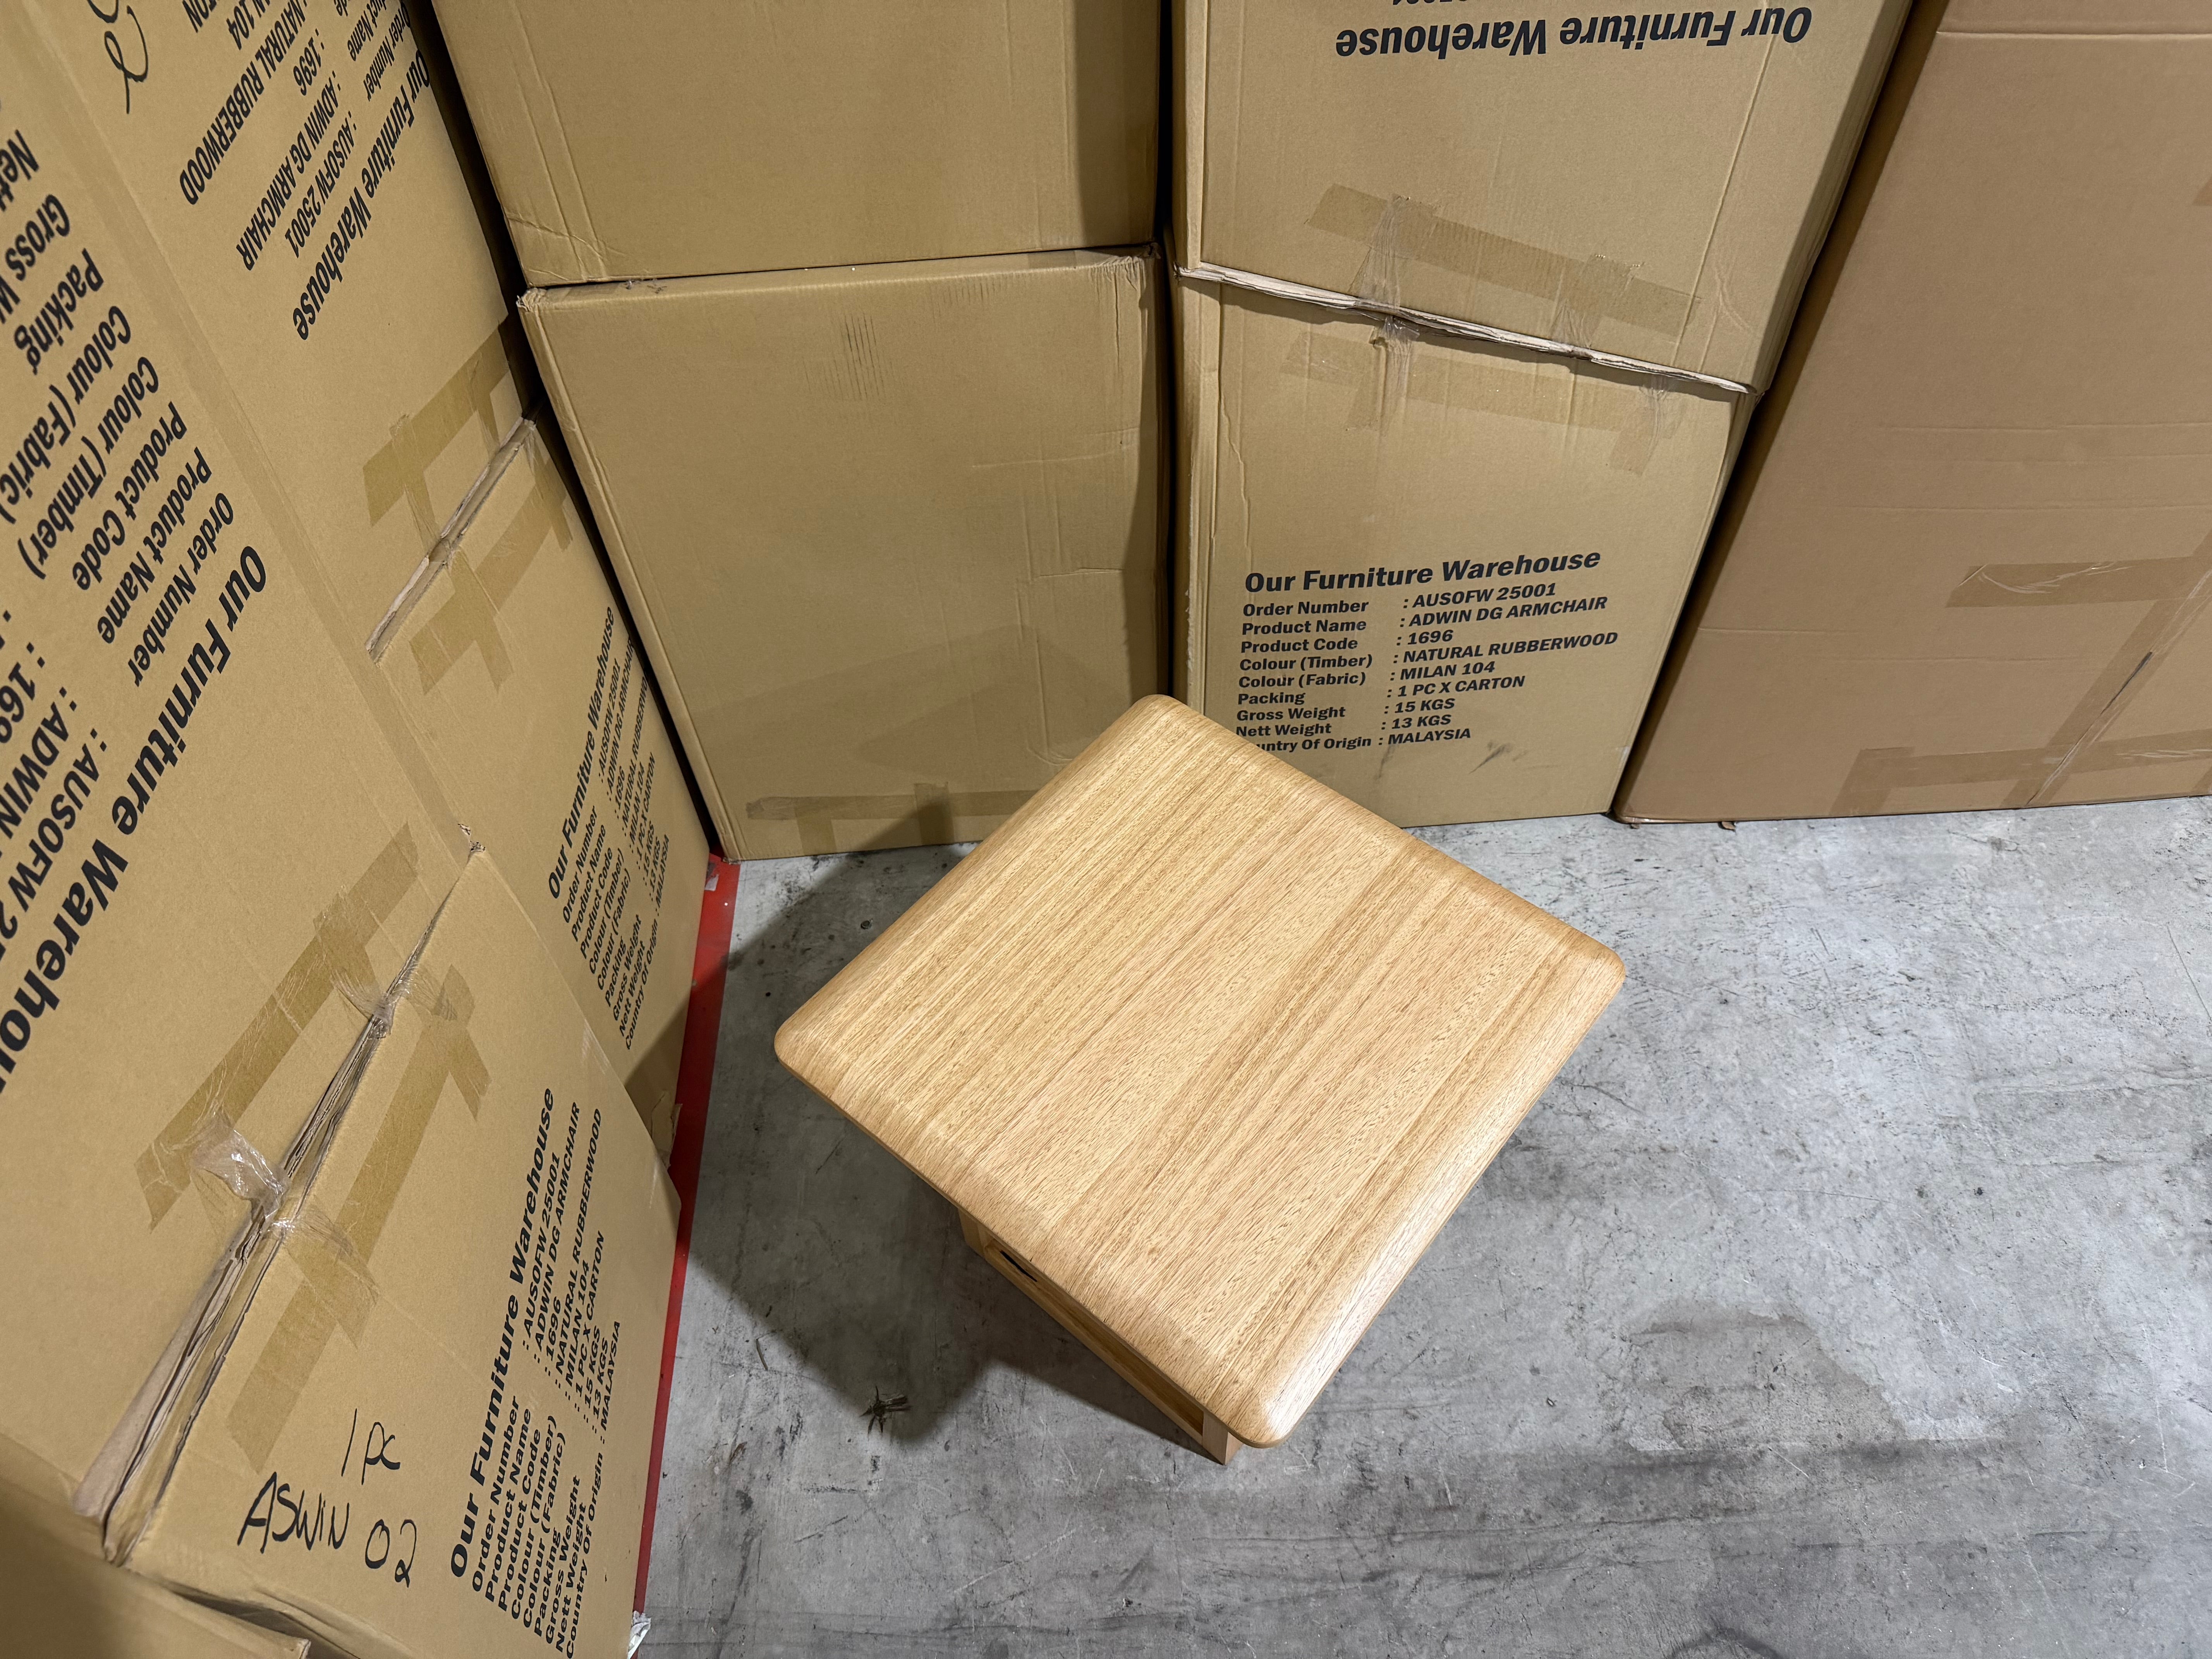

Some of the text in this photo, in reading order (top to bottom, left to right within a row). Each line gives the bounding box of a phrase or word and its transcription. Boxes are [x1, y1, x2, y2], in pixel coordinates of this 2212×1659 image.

[226, 0, 254, 51] 104
[255, 0, 306, 79] NATURAL
[293, 37, 321, 96] 1696
[363, 36, 395, 102] Number
[1336, 7, 1812, 60] Our Furniture Warehouse
[180, 61, 264, 205] RUBBERWOOD
[236, 10, 374, 271] Name ADWIN DG ARMCHAIR
[293, 42, 430, 340] Our Furniture Warehouse
[315, 117, 354, 205] AUSOFW
[5, 194, 70, 281] Gross
[285, 184, 321, 258] 25001
[14, 248, 104, 375] Packing
[67, 306, 131, 405] Colour
[17, 357, 159, 580] Colour (Timber)
[114, 401, 187, 521] Product
[143, 447, 212, 565] Product
[72, 510, 125, 590] Code
[97, 551, 155, 644] Name
[218, 546, 266, 632] Our
[1242, 596, 1607, 635] Product Name ADWIN DG ARMCHAIR
[1243, 582, 1556, 617] Order Number AUSOFW 25001
[1245, 552, 1601, 592] Our Furniture Warehouse
[8, 493, 234, 912] Order Number AUSOFW
[1237, 698, 1455, 721] Gross Weight 15 KGS
[1238, 675, 1525, 705] Packing 1 PC X CARTON
[1239, 661, 1495, 688] Colour (Fabric) MILAN 104
[1240, 632, 1618, 671] Colour (Timber) NATURAL RUBBERWOOD
[1241, 629, 1454, 653] Product Code 1696
[112, 618, 231, 835] Furniture
[548, 606, 614, 899] Our Furniture Warehouse
[563, 658, 620, 923] Order Number AUSOFW 25001
[1236, 714, 1451, 737] Nett Weight 13 KGS
[1256, 728, 1471, 753] untry Of Origin MALAYSIA
[571, 871, 594, 942] Product
[589, 824, 606, 874] Name
[607, 735, 619, 794] ADWIN
[615, 713, 623, 741] DG
[580, 766, 625, 959] Product Code 1696
[589, 677, 647, 974] Colour (Timber) NATURAL RUBBERWO
[598, 933, 615, 990] Colour
[611, 868, 630, 936] (Fabric)
[629, 791, 641, 845] MILAN
[605, 752, 655, 1007] Packing 1 PC X CARTON
[613, 820, 654, 1021] Gross Weight 15 KGS
[619, 997, 632, 1037] Nett
[628, 940, 645, 997] Weight
[650, 869, 656, 893] 13
[625, 834, 669, 1050] Country Of Origin MALAYSIA
[451, 1088, 553, 1577] Our Furniture Warehouse
[472, 1152, 560, 1592] Order Number AUSOFW 25001
[485, 1102, 580, 1602] Product Name ADWIN DG ARMCHAIR
[511, 1108, 601, 1619] Colour (Timber) NATURAL RUBBERWOOD
[498, 1296, 561, 1612] Product Code 1696
[523, 1260, 589, 1628] Colour (Fabric) MILAN 104
[534, 1230, 604, 1637] Packing 1 PC X CARTON
[546, 1325, 600, 1644] Gross Weight 15 KGS
[556, 1337, 608, 1653] Nett Weight 13 KGS
[566, 1321, 620, 1659] Country Of Origin MALAYSIA
